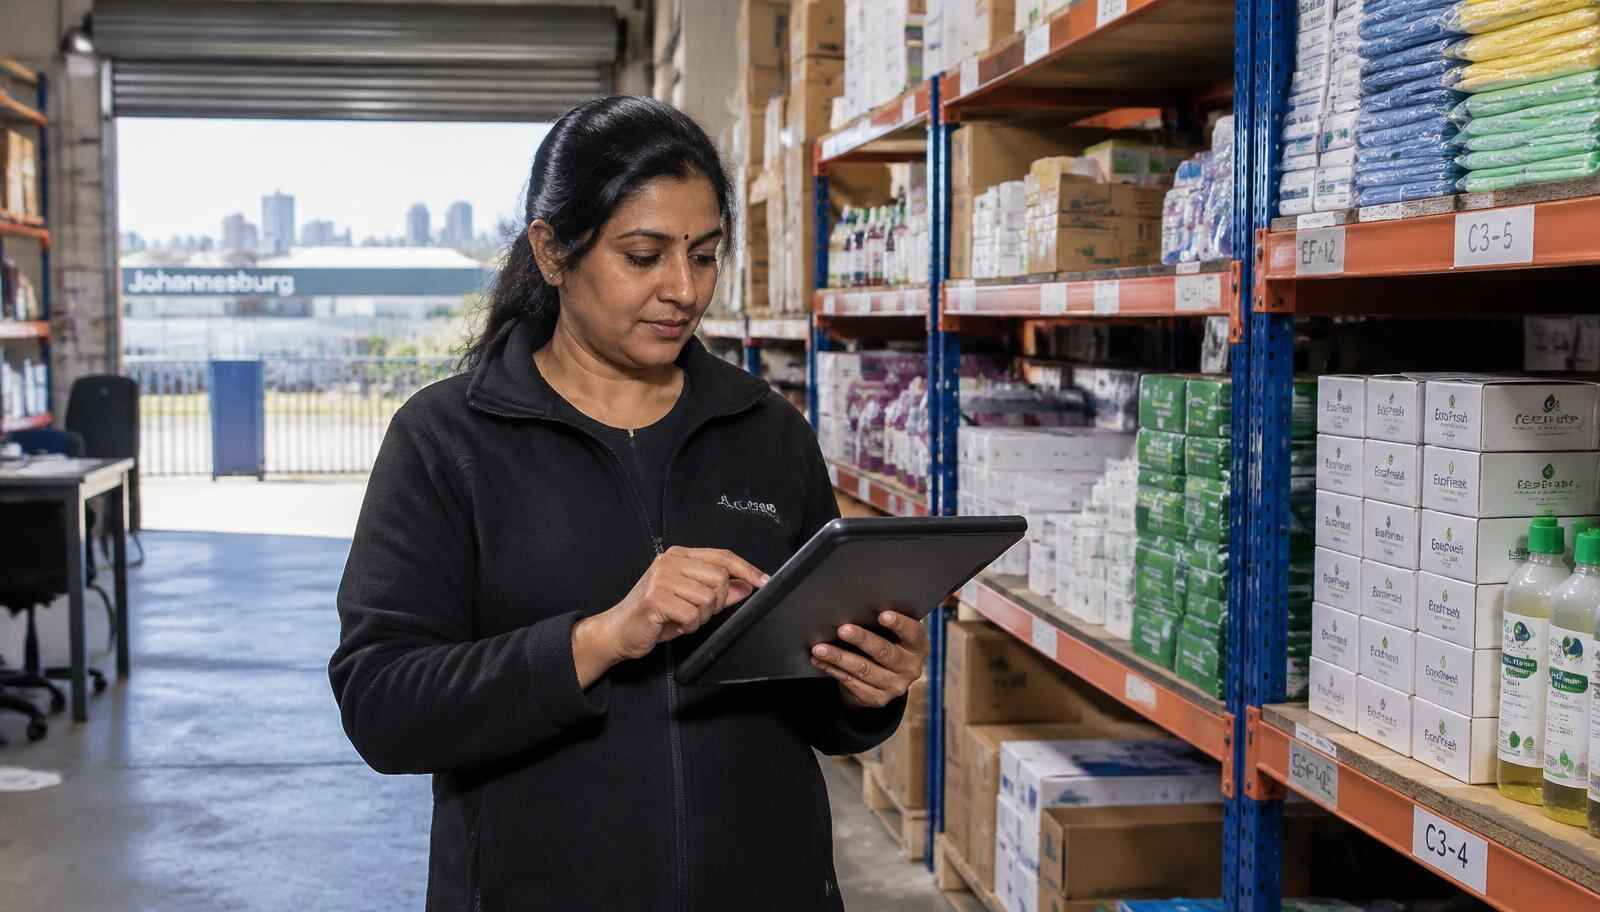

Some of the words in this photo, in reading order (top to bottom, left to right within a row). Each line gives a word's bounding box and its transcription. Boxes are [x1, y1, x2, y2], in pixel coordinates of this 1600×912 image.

[1468, 220, 1513, 253] C3-5
[128, 270, 295, 297] Johannesburg
[1426, 823, 1468, 869] C3-4
